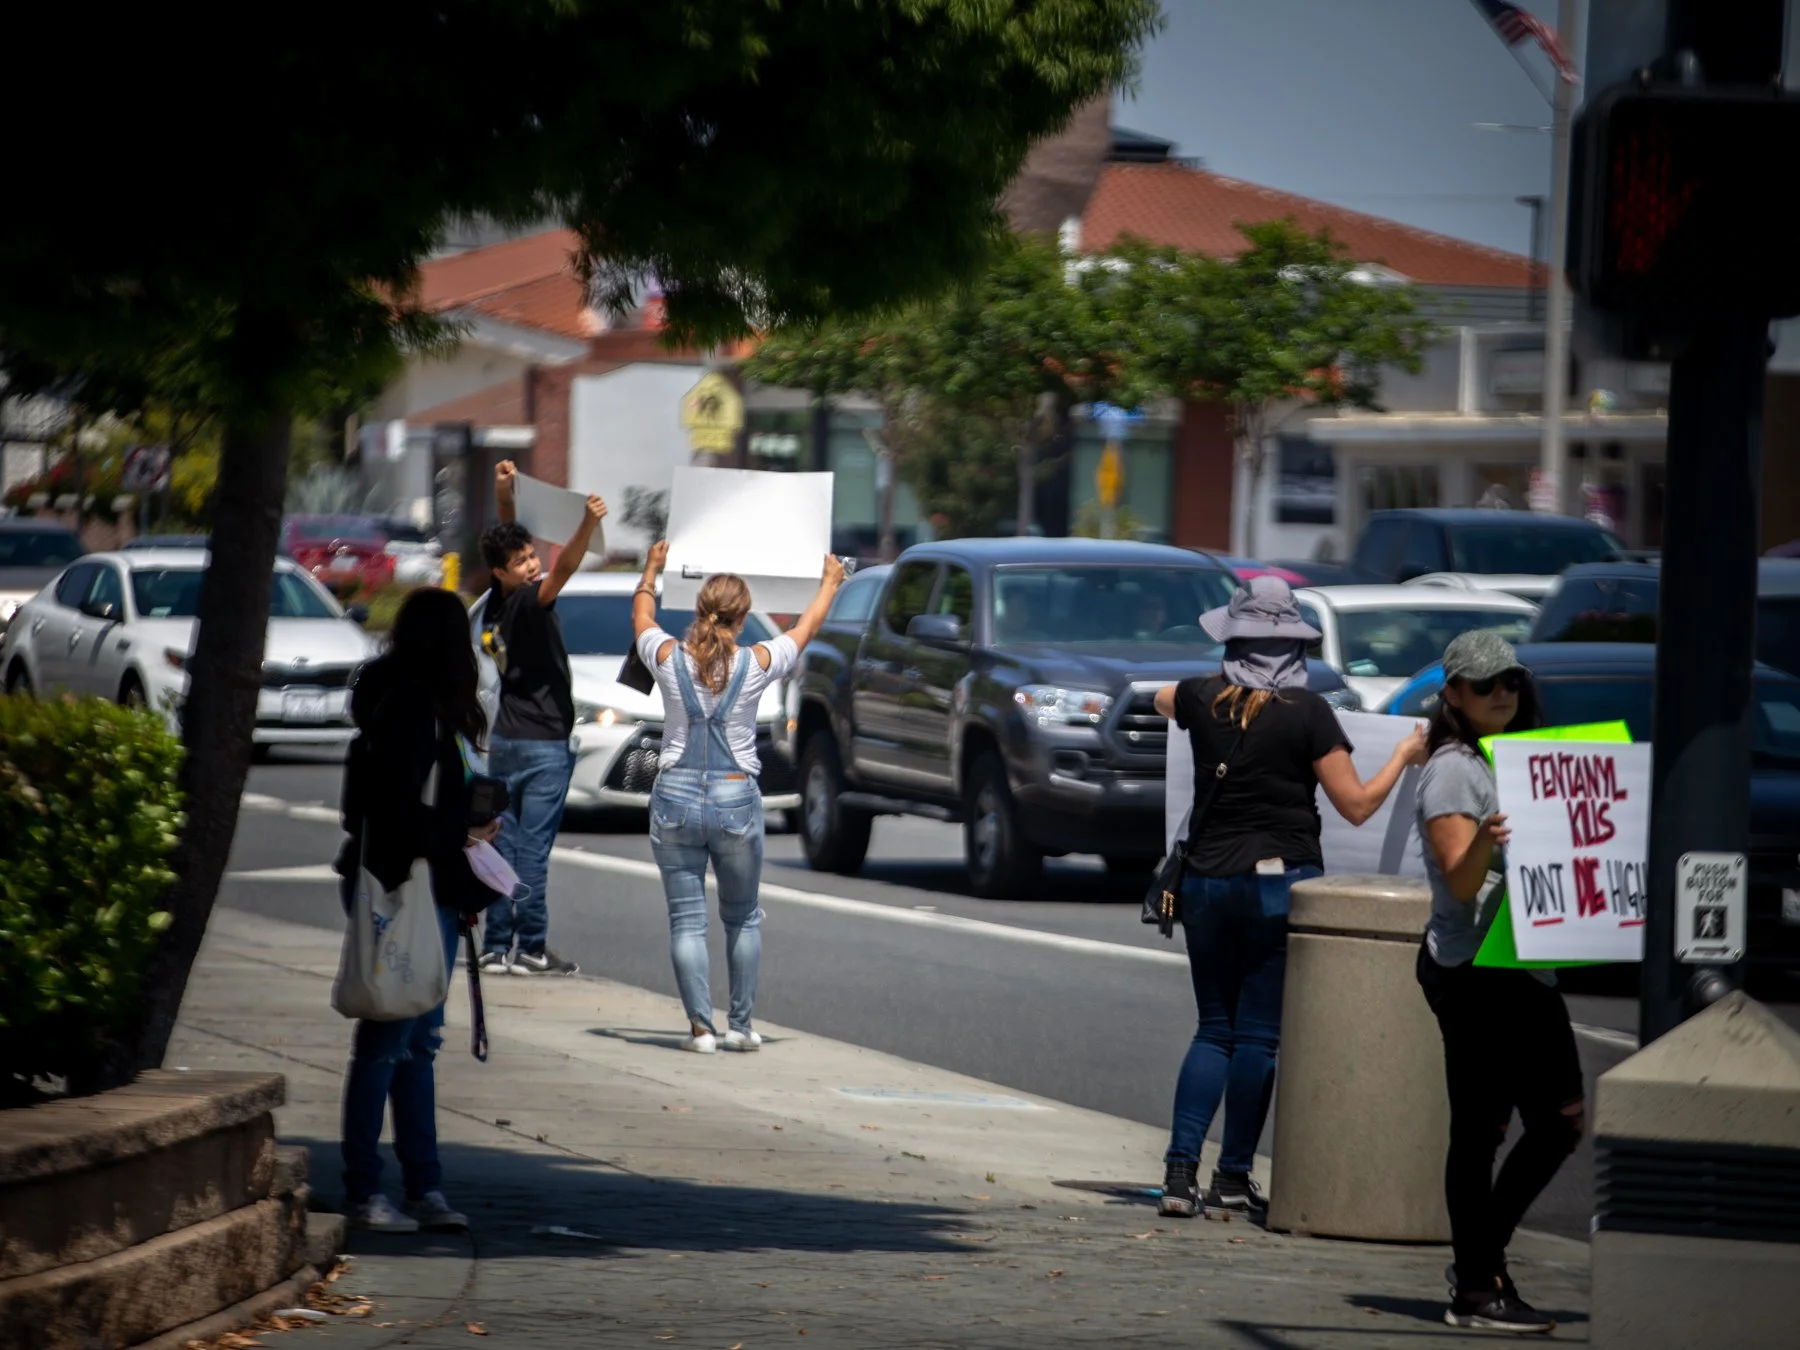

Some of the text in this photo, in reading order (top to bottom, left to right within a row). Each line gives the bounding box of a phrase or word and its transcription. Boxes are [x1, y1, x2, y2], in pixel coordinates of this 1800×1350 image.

[1528, 752, 1628, 802] FENTANYL
[1567, 799, 1616, 848] KILLS
[1694, 863, 1730, 876] PUSH
[1685, 876, 1737, 890] BUTTON
[1698, 890, 1724, 903] FOR
